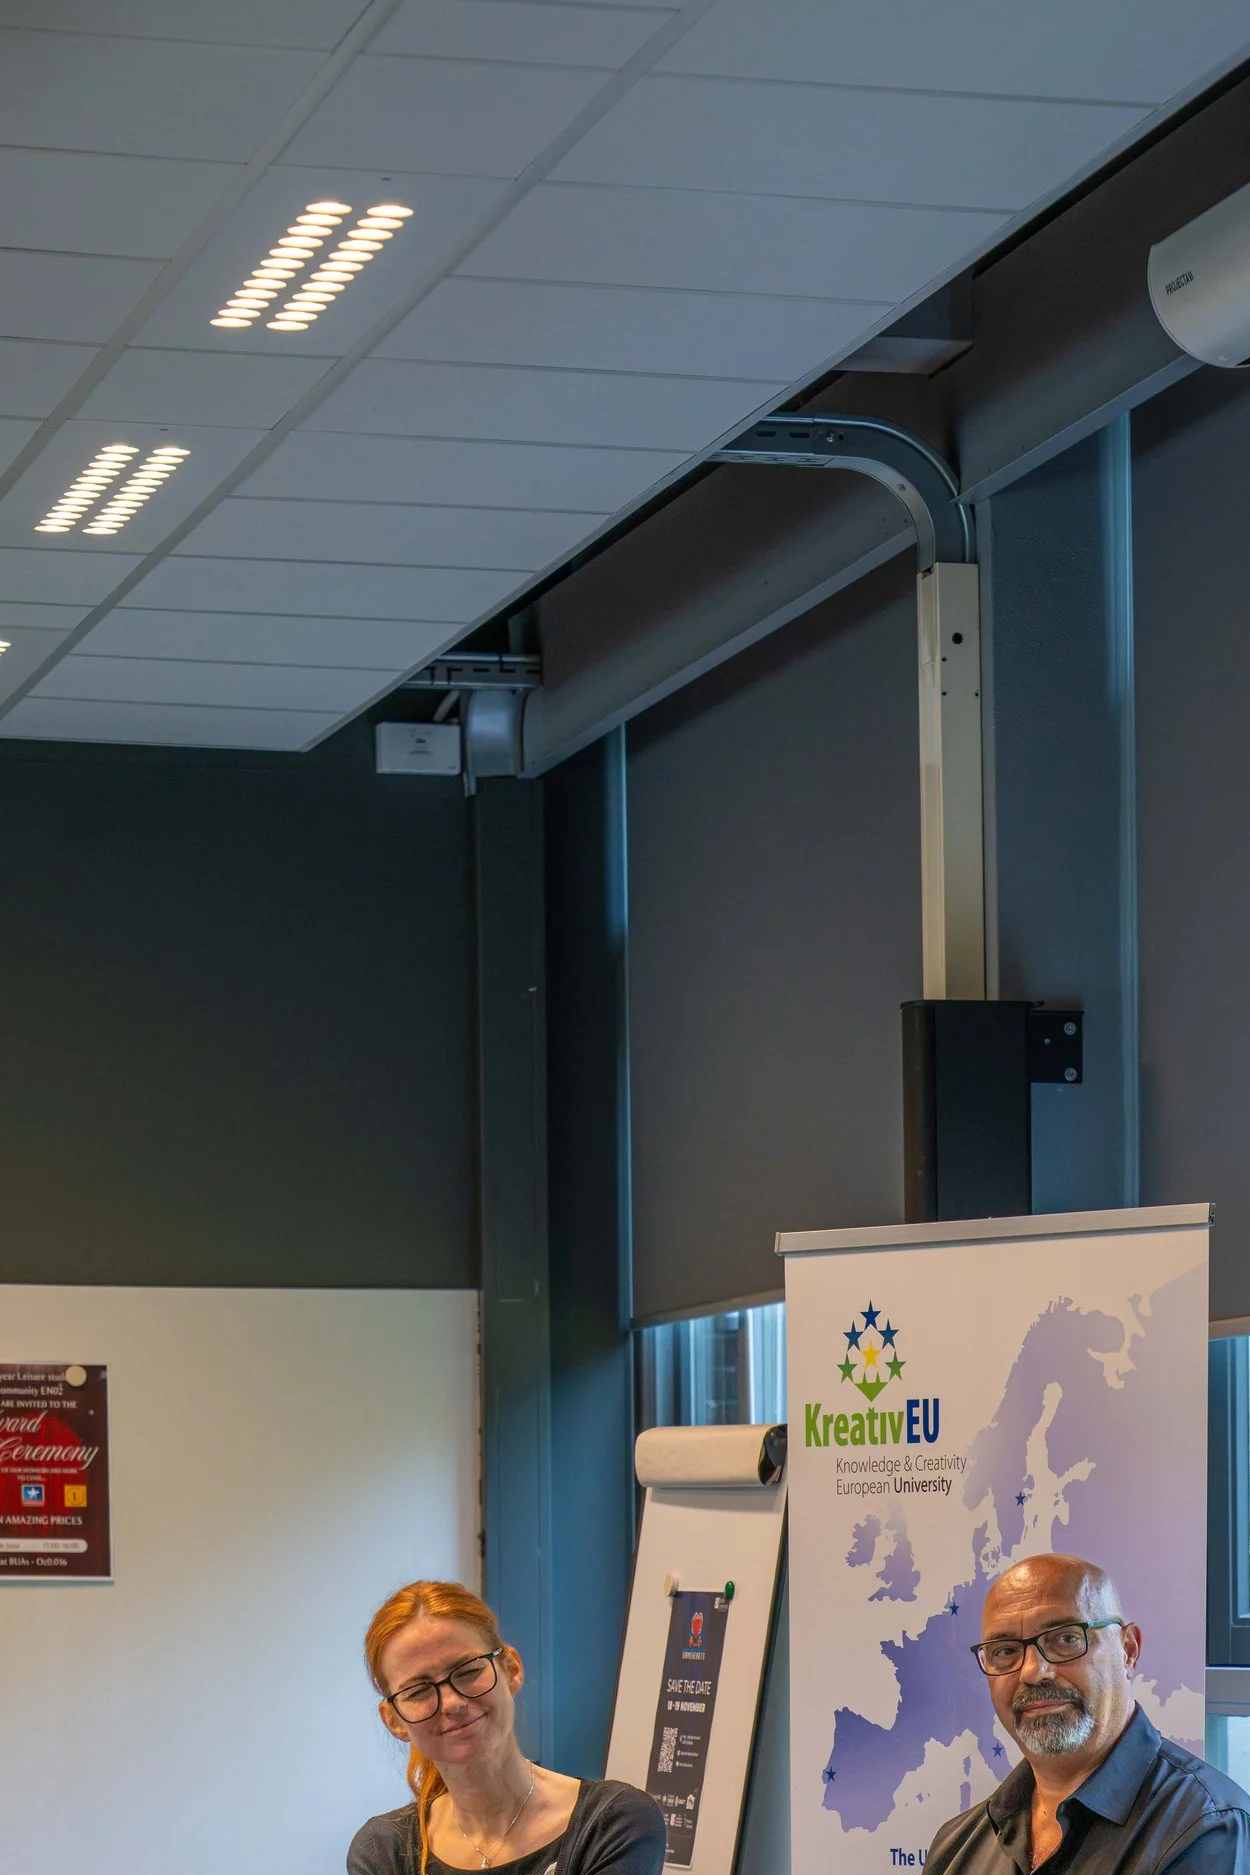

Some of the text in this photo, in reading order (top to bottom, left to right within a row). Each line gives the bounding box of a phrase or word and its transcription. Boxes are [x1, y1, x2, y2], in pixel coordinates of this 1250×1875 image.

[17, 1373, 45, 1381] Leisure
[1, 1400, 15, 1408] ARE
[16, 1400, 47, 1408] INVITED
[805, 1398, 940, 1448] KreativEU
[836, 1454, 967, 1476] Knowledge & Creativity
[836, 1475, 952, 1498] European University
[5, 1516, 49, 1525] AMAZING
[51, 1516, 83, 1525] PRICES
[667, 1678, 712, 1695] SAVE THE DATE
[680, 1701, 706, 1713] NOVEMBER
[890, 1848, 915, 1866] The
